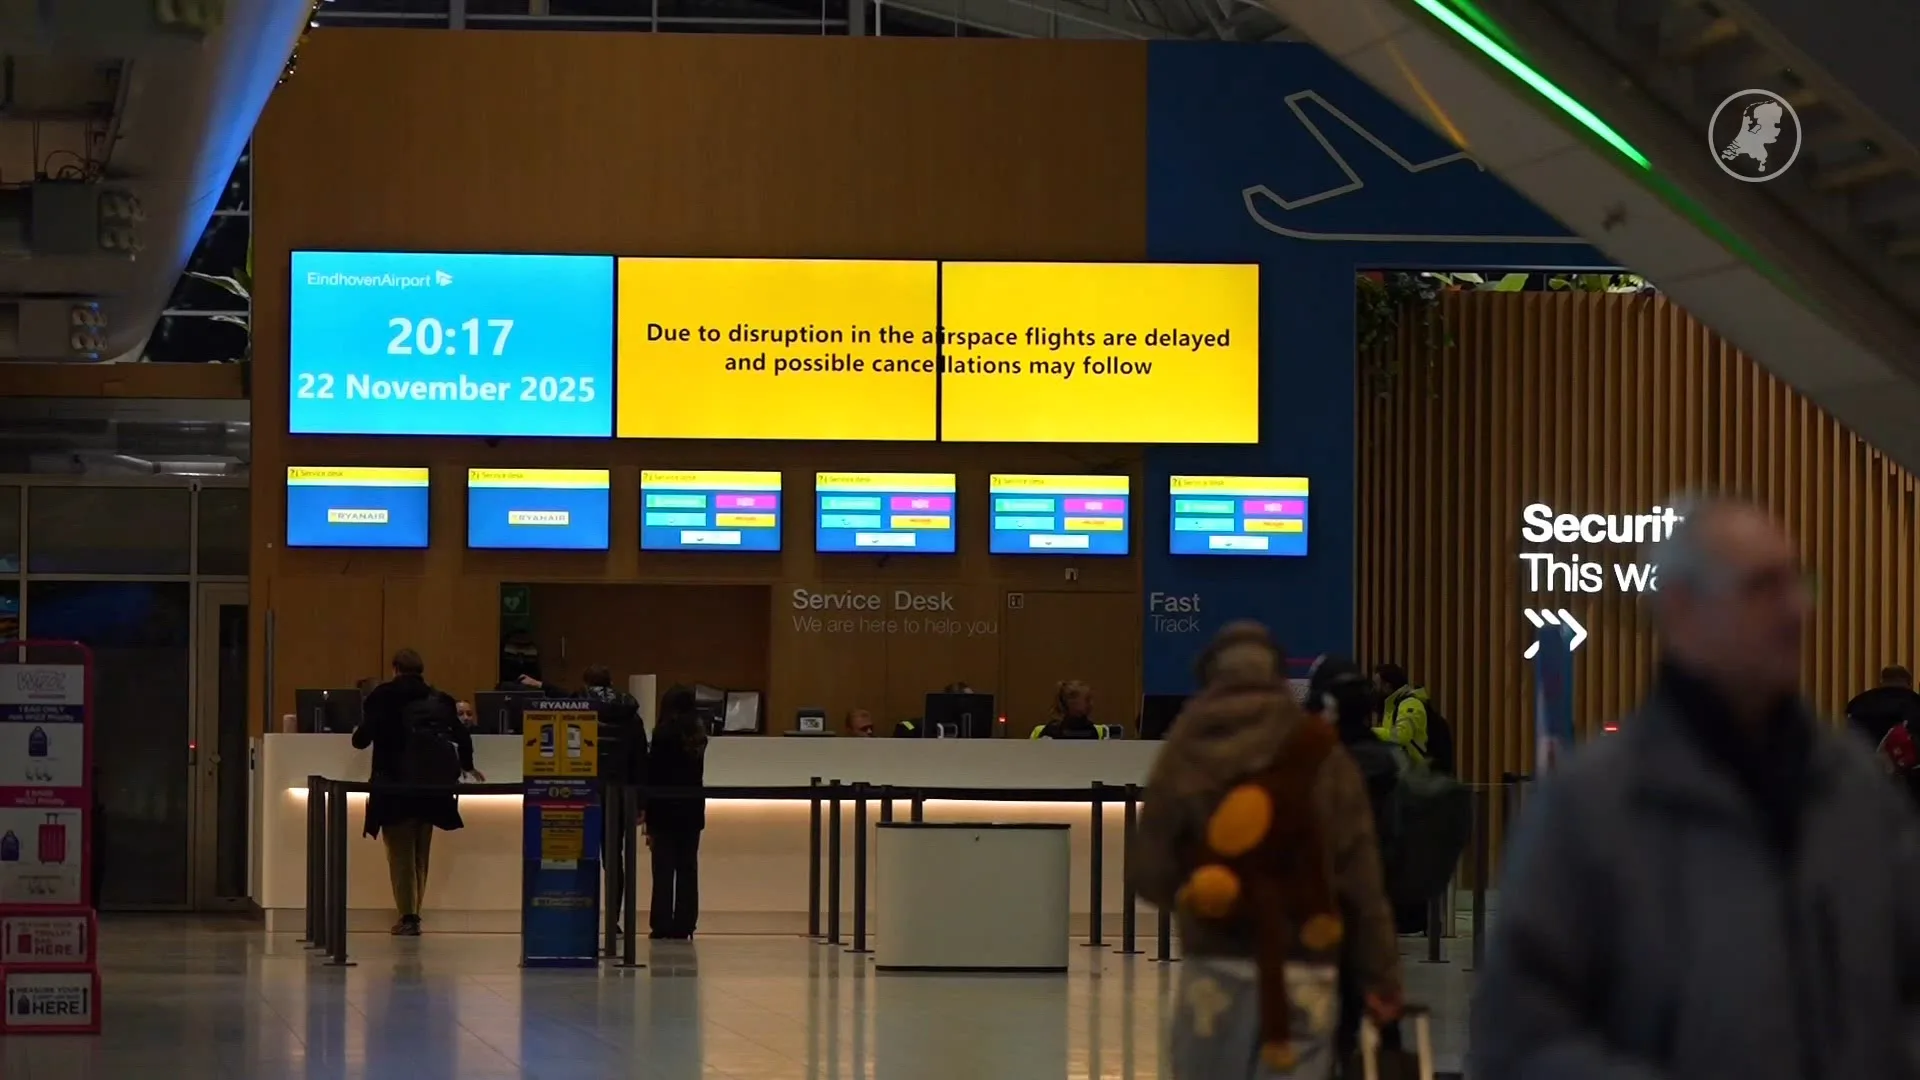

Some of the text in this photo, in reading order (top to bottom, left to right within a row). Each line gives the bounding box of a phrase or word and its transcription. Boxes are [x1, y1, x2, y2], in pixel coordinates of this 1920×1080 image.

[307, 271, 431, 290] EindhovenAirport
[386, 317, 515, 356] 20:17
[647, 323, 1230, 352] Due to disruption in the airspace flights are delayed
[725, 352, 1152, 380] and possible cancellations may follow
[297, 373, 595, 403] 22 November 2025
[337, 512, 386, 521] RYANAIR
[518, 513, 567, 522] RYANAIR
[1521, 503, 1684, 543] Securit
[1519, 552, 1603, 593] This
[792, 589, 954, 611] Service Desk
[1149, 592, 1201, 613] Fast
[792, 616, 998, 637] We are here to help you
[1153, 615, 1200, 633] Track
[539, 700, 590, 709] RYANAIR
[35, 944, 73, 955] HERE
[33, 1001, 80, 1015] HERE
